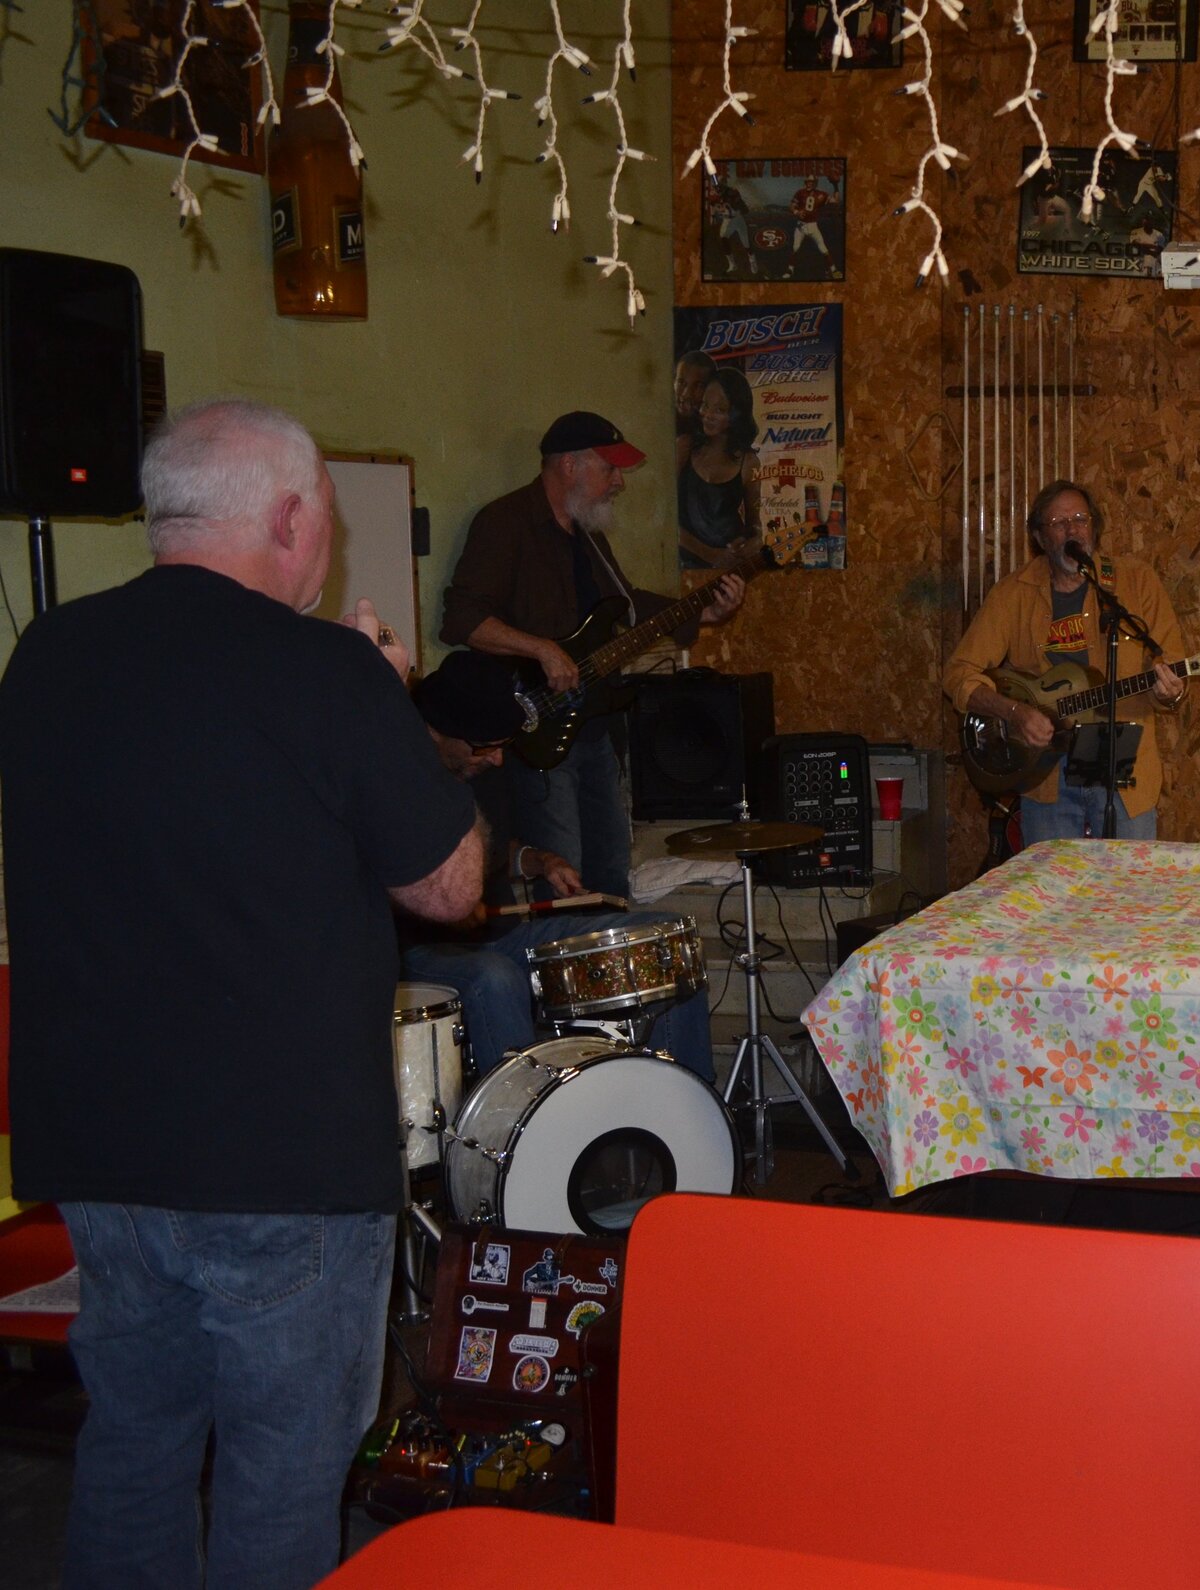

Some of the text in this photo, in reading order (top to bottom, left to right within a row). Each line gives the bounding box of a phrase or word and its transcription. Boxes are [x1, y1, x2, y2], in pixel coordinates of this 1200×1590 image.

[805, 195, 815, 212] 8
[1021, 239, 1142, 258] CHICAGO
[1022, 255, 1142, 272] WHITE SOX
[699, 306, 827, 354] BUSCH
[744, 352, 836, 373] BUSCH
[761, 392, 829, 405] Budweiser
[766, 413, 824, 421] BUD LIGHT
[761, 423, 833, 445] Natural
[751, 465, 825, 482] MICHELOB
